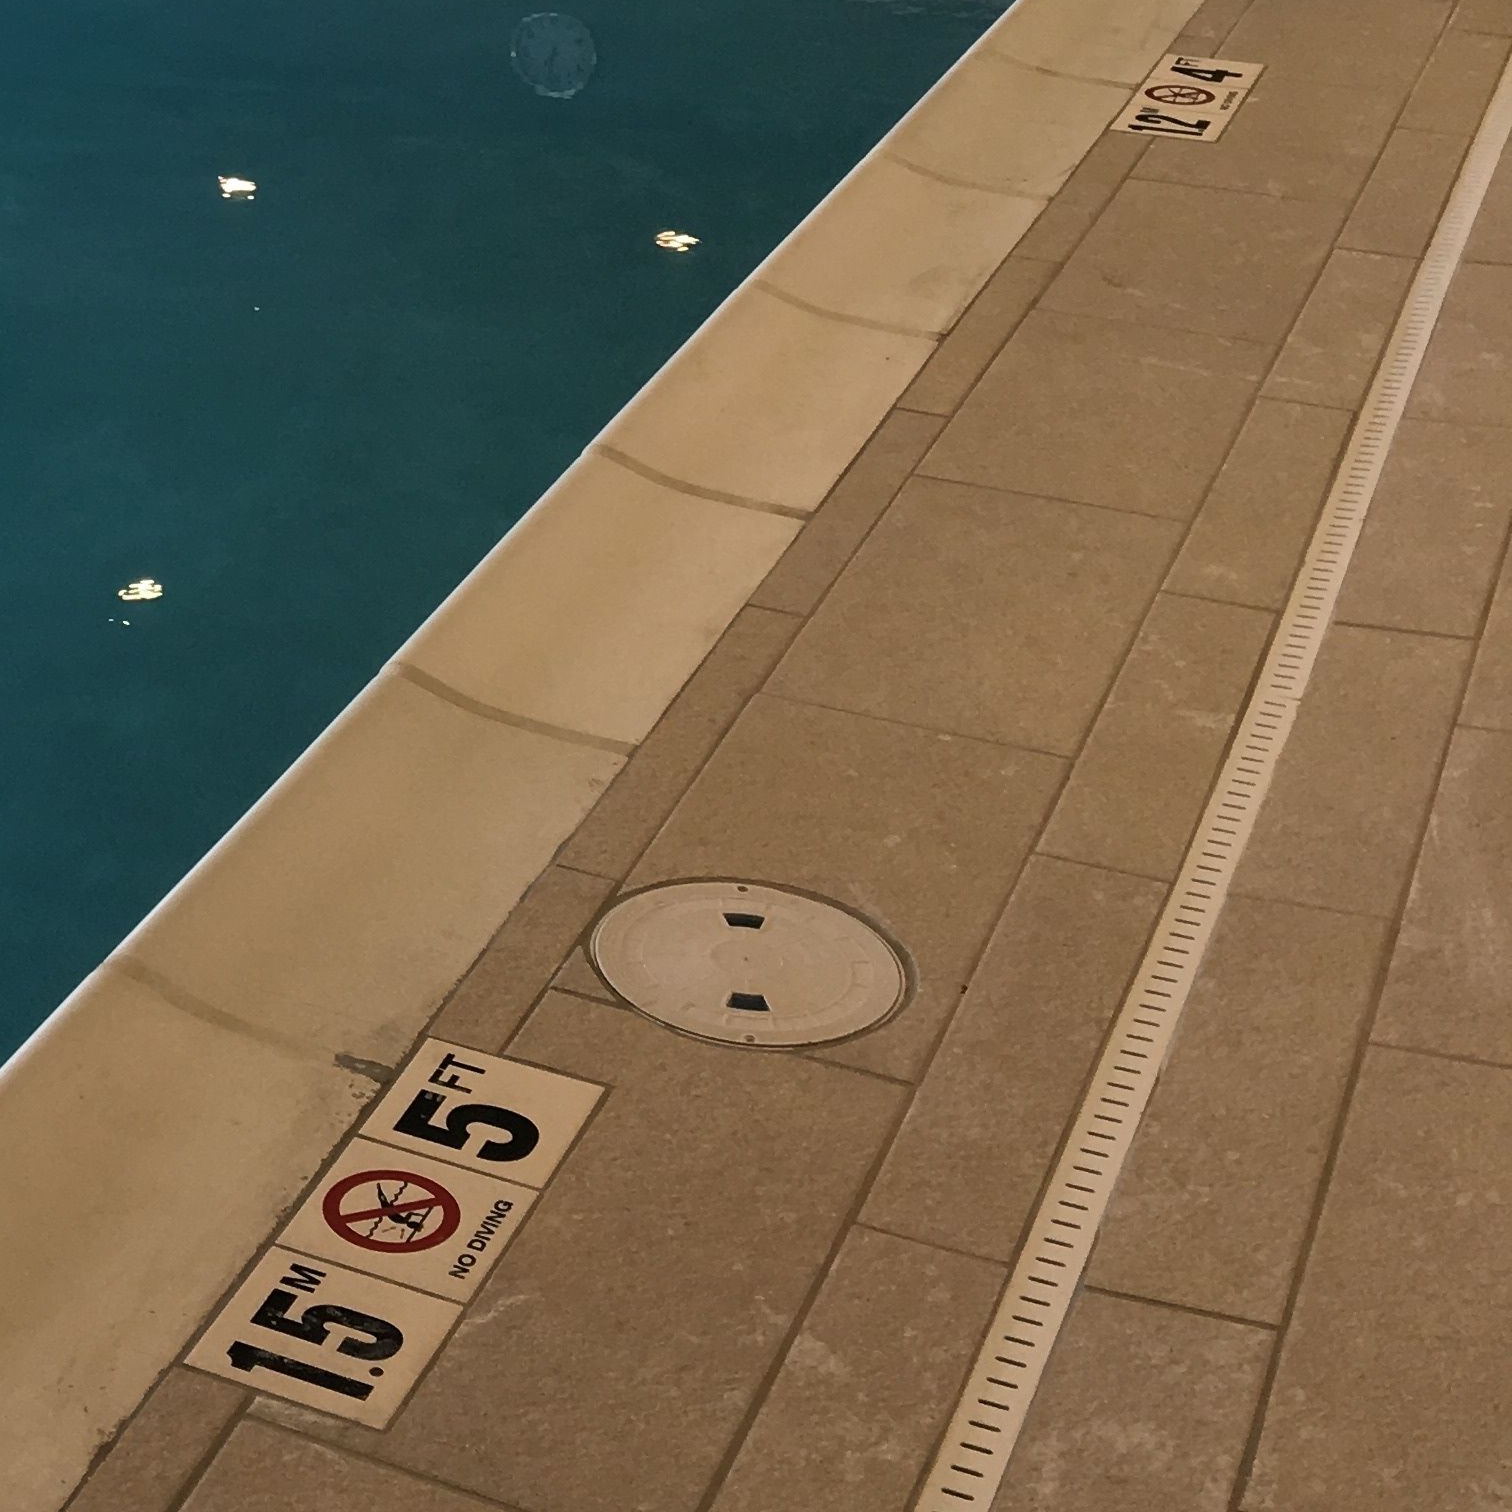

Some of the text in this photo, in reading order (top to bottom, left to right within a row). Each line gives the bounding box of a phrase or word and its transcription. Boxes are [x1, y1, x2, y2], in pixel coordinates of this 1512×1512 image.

[1170, 65, 1243, 83] 4
[393, 1052, 540, 1162] 5 FT
[448, 1198, 514, 1280] NO DIVING
[226, 1263, 404, 1402] 1.5 M
